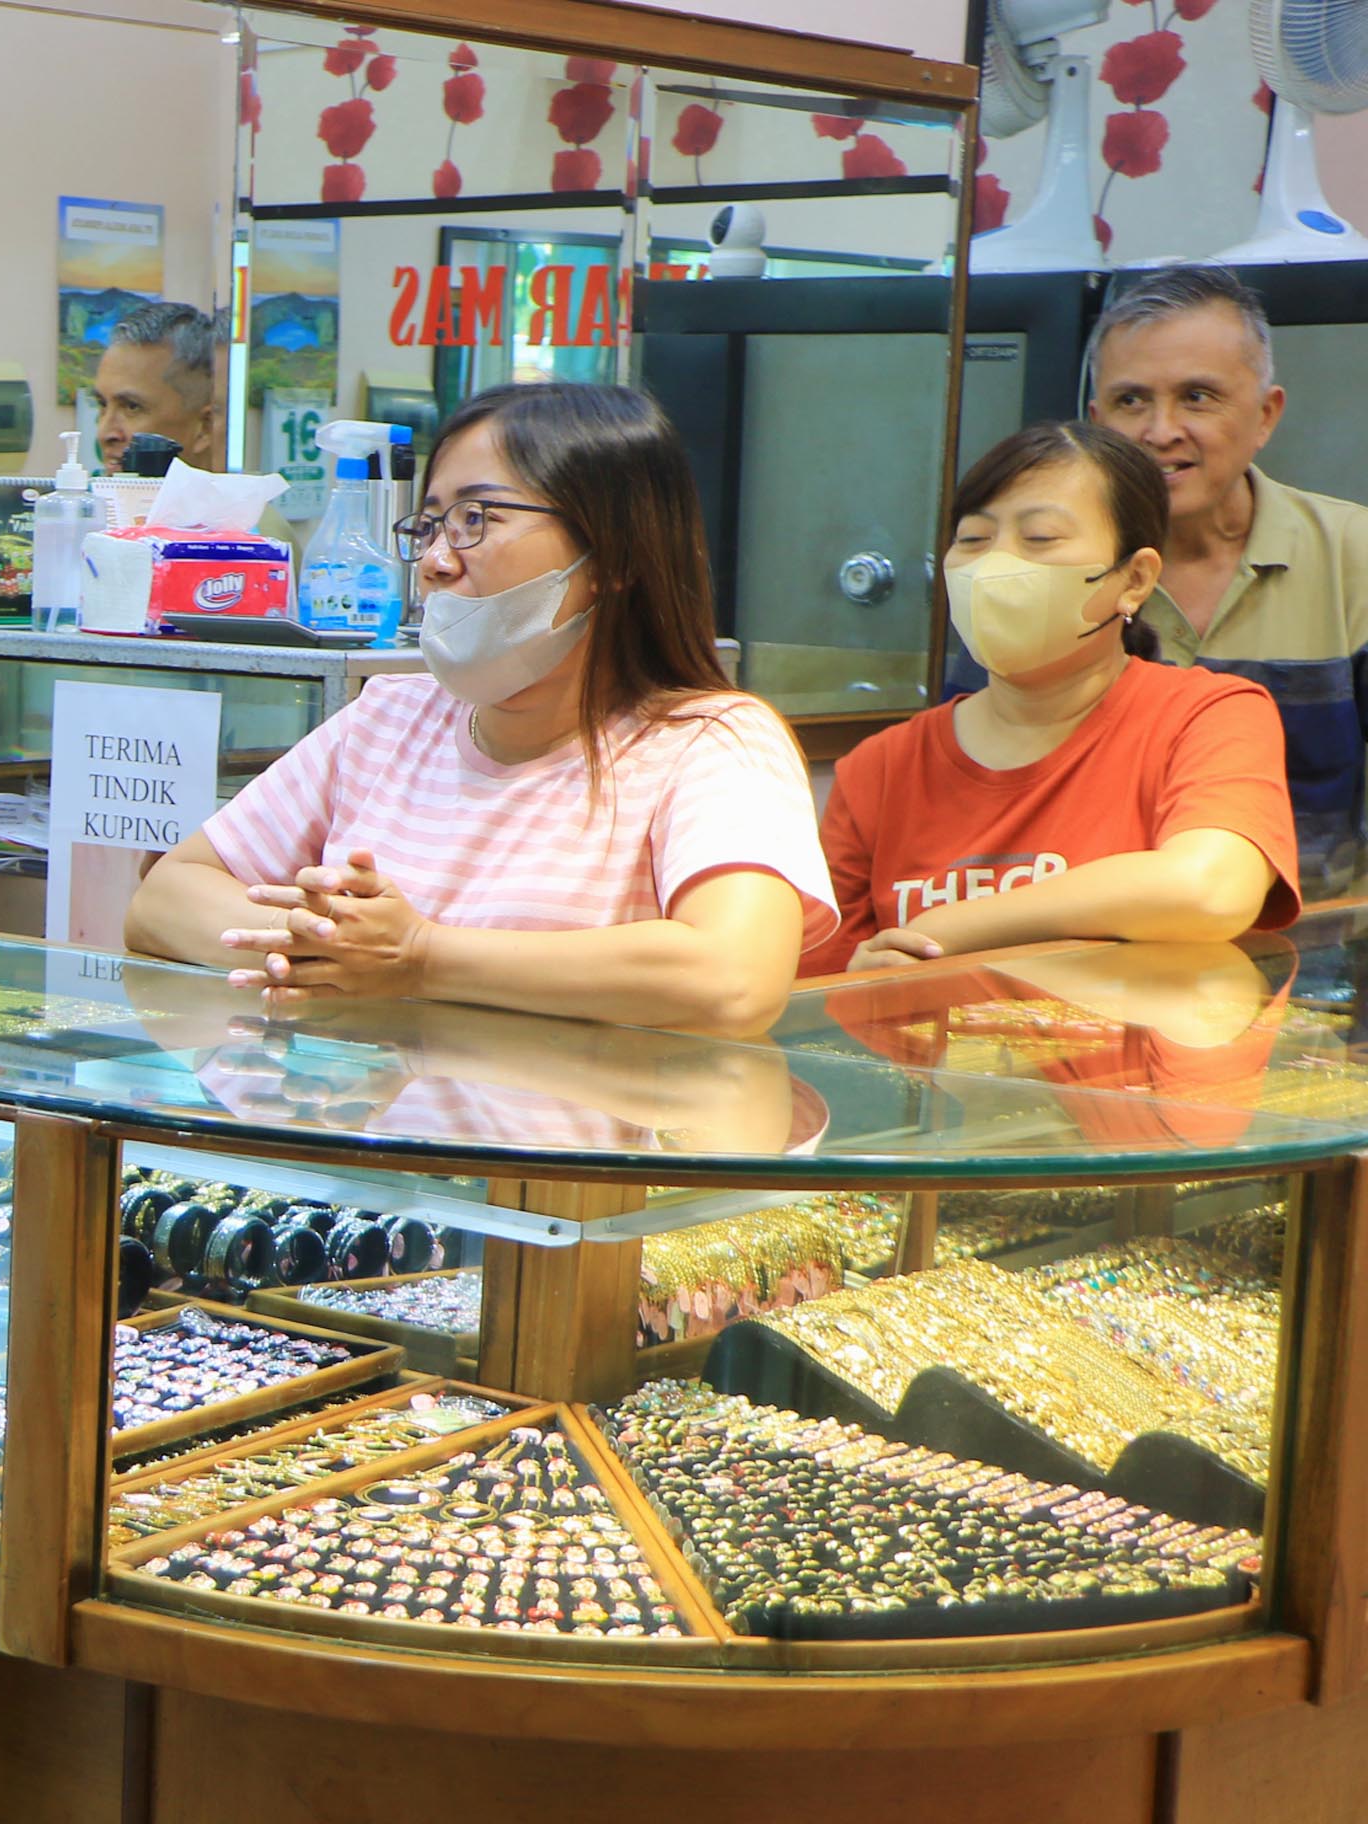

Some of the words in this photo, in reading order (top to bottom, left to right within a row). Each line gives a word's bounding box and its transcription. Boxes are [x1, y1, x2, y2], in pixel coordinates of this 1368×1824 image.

[204, 573, 245, 599] Jolly
[85, 734, 182, 766] TERIMA
[89, 773, 177, 806] TINDIK
[84, 811, 180, 846] KUPING
